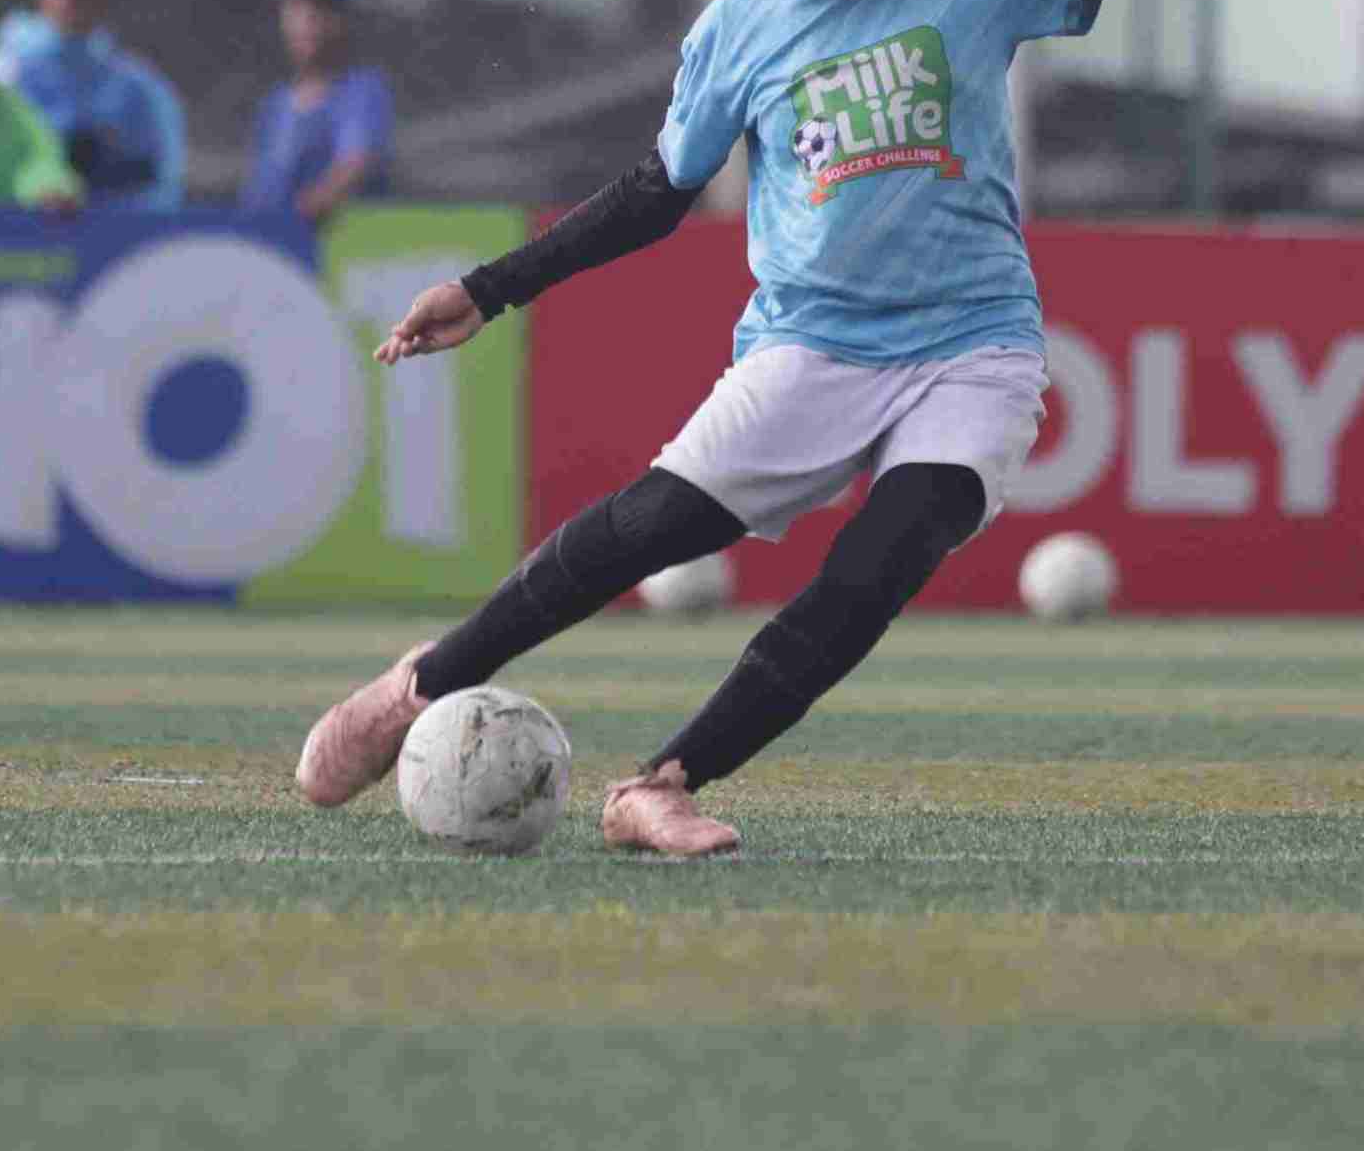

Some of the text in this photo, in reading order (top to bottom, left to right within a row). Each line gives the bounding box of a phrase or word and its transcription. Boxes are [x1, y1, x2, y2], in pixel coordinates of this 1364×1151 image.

[804, 41, 939, 114] Milk
[836, 92, 943, 154] Life
[824, 148, 941, 183] SOCCER CHALLENGE
